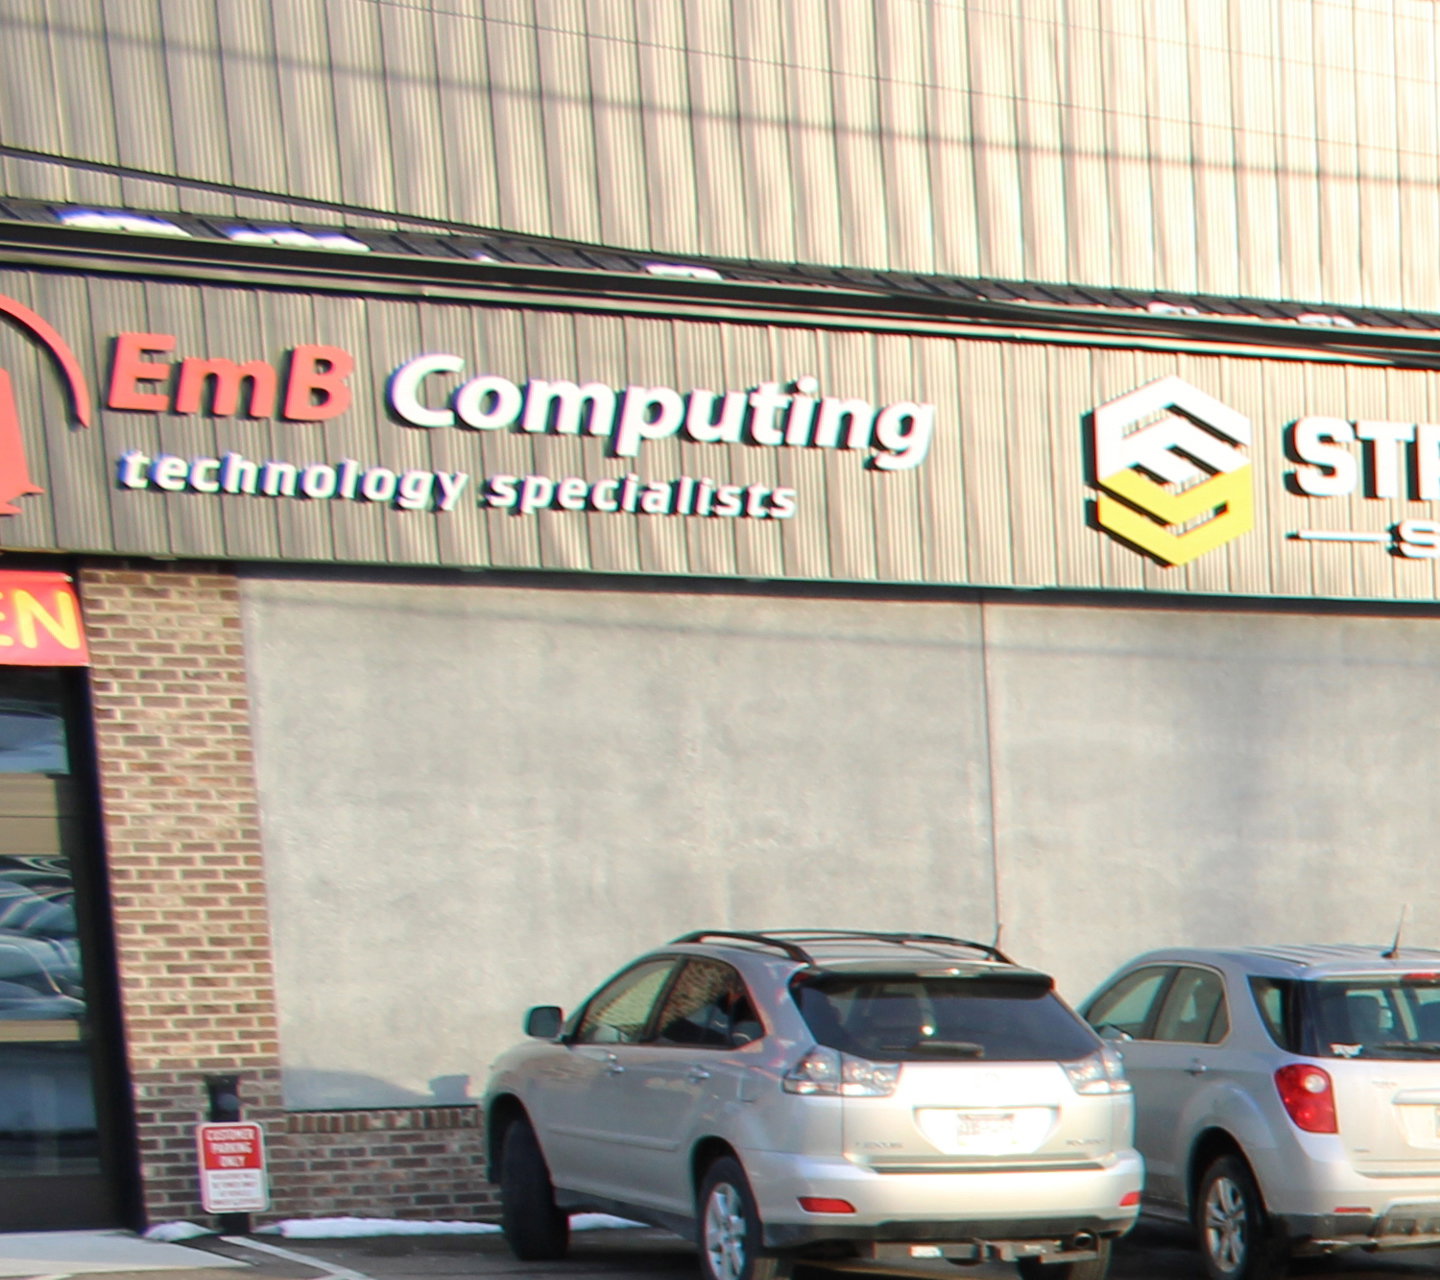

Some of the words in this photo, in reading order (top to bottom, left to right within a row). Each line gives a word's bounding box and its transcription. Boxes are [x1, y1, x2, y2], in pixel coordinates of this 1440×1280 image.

[108, 331, 354, 422] EmB
[391, 353, 936, 471] Computing
[121, 448, 470, 512] technology
[486, 470, 798, 520] specialists
[0, 590, 80, 649] N
